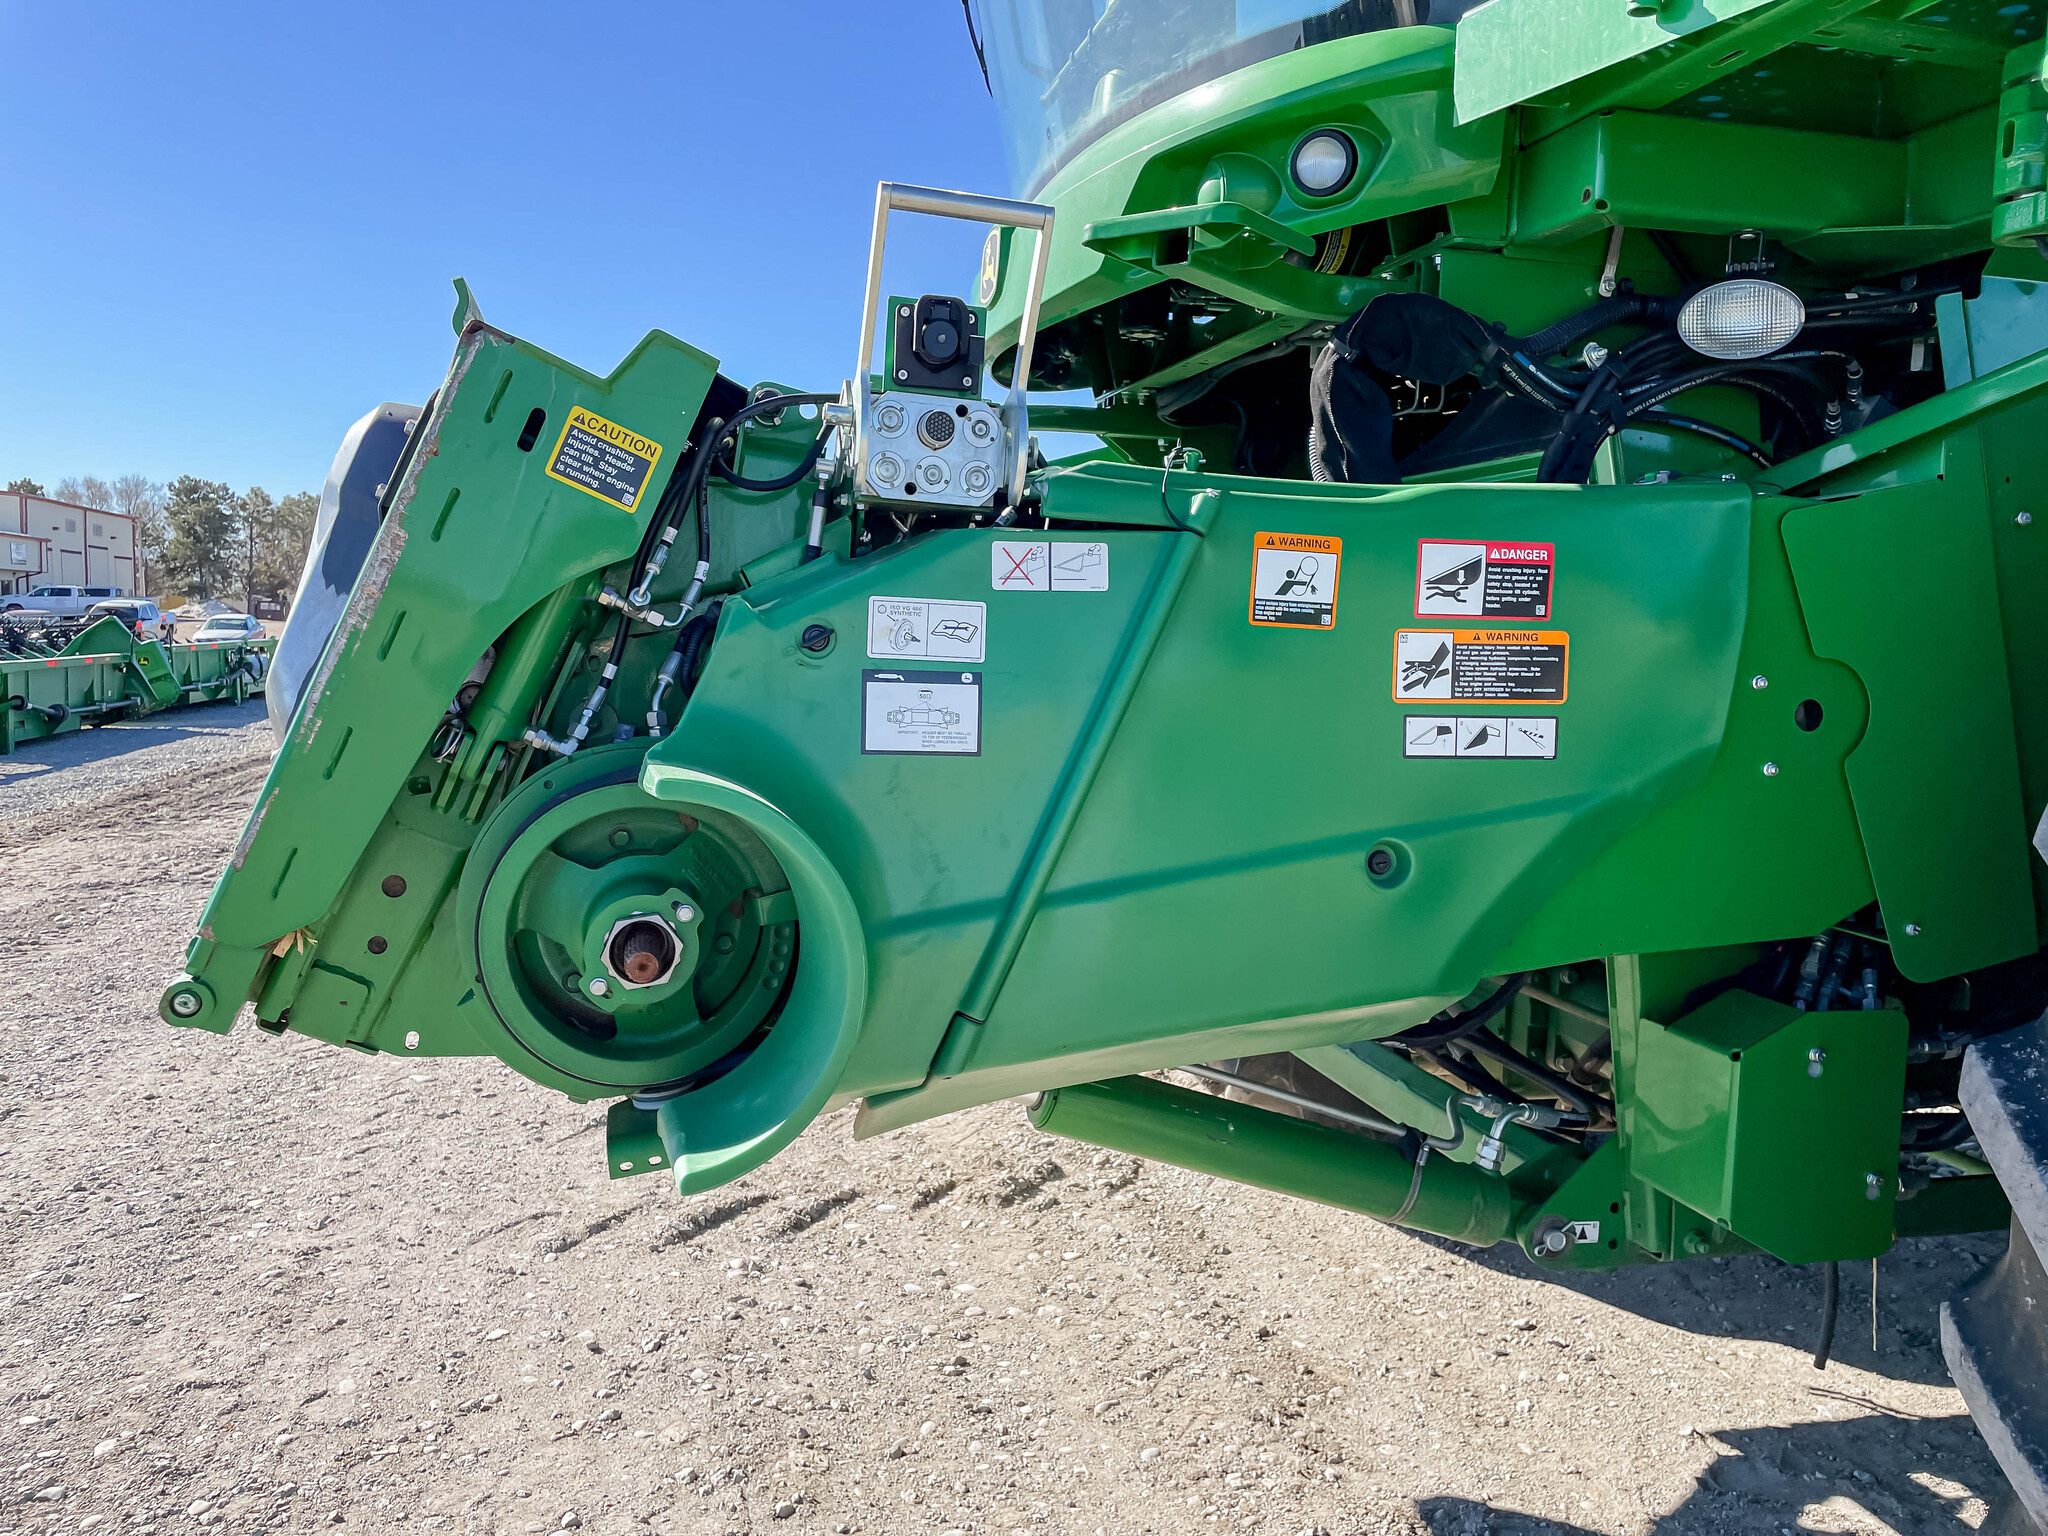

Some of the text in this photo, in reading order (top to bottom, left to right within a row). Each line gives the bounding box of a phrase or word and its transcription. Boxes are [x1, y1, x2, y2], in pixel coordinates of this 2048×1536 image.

[571, 429, 634, 463] Avoid crushing
[587, 418, 657, 458] CAUTION
[564, 447, 618, 476] can tilt. Stay
[568, 437, 635, 473] injuries. Header
[556, 462, 600, 488] is running.
[560, 455, 635, 493] clear when engine
[1279, 537, 1330, 549] WARNING
[1501, 549, 1548, 560] DANGER
[1486, 633, 1538, 642] WARNING
